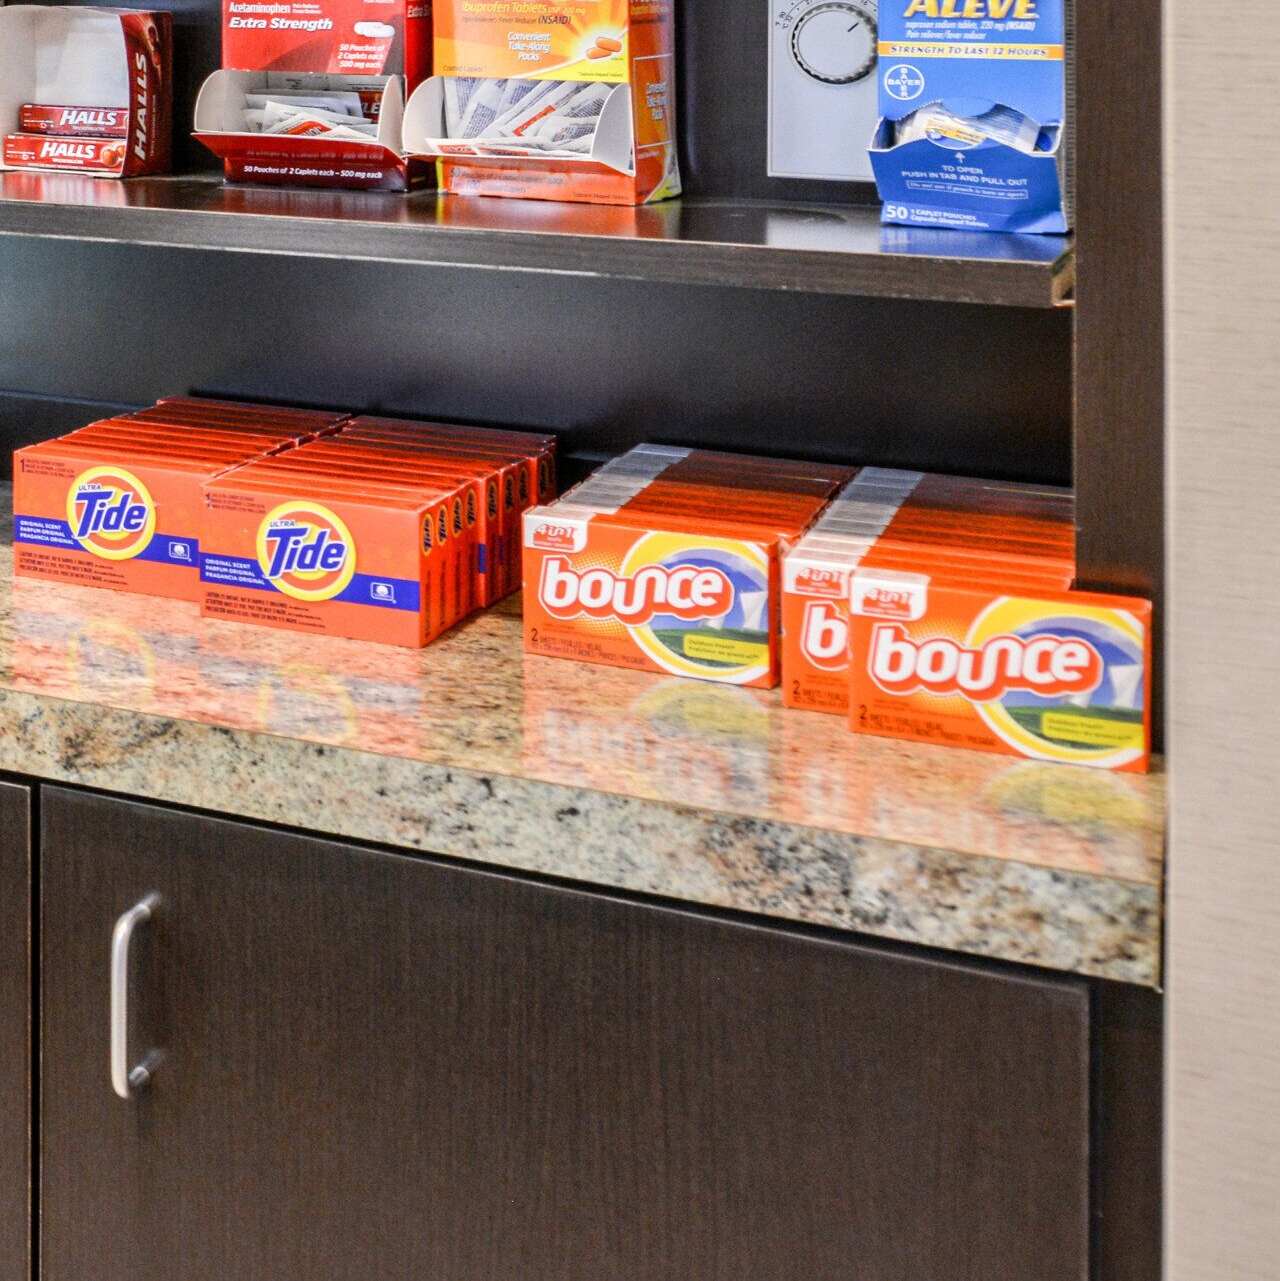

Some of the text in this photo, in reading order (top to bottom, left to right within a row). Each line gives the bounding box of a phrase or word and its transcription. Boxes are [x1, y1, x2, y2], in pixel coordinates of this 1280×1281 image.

[229, 2, 291, 14] Acetaminophen
[462, 2, 510, 14] Ibuprofen
[512, 3, 547, 13] Tablets
[229, 18, 333, 31] Extra Strength
[538, 16, 572, 25] (NSAID)
[508, 32, 551, 41] Convenient
[508, 42, 551, 53] Take-Along
[890, 46, 1047, 56] STRENGTH LAST 12 HOURS
[344, 53, 367, 61] Caplets
[518, 53, 541, 61] Packs
[134, 53, 147, 160] HALLS
[60, 110, 117, 126] HALLS
[40, 142, 96, 158] HALLS
[253, 166, 279, 174] Pouches
[295, 168, 318, 177] Caplets
[341, 170, 354, 178] 500
[981, 176, 1003, 184] PULL
[1007, 178, 1028, 186] OUT
[886, 206, 908, 218] 50
[75, 491, 147, 538] Tide
[20, 520, 44, 529] ORIGINAL
[536, 523, 575, 539] 4in1
[266, 527, 345, 577] Tide
[205, 559, 232, 568] ORIGINAL
[229, 569, 255, 577] ORIGINAL
[239, 576, 265, 585] ORIGINAL
[543, 560, 723, 615] bounce
[532, 628, 538, 641] 2
[874, 625, 1090, 691] bounce
[793, 681, 801, 695] 2
[860, 705, 868, 719] 2
